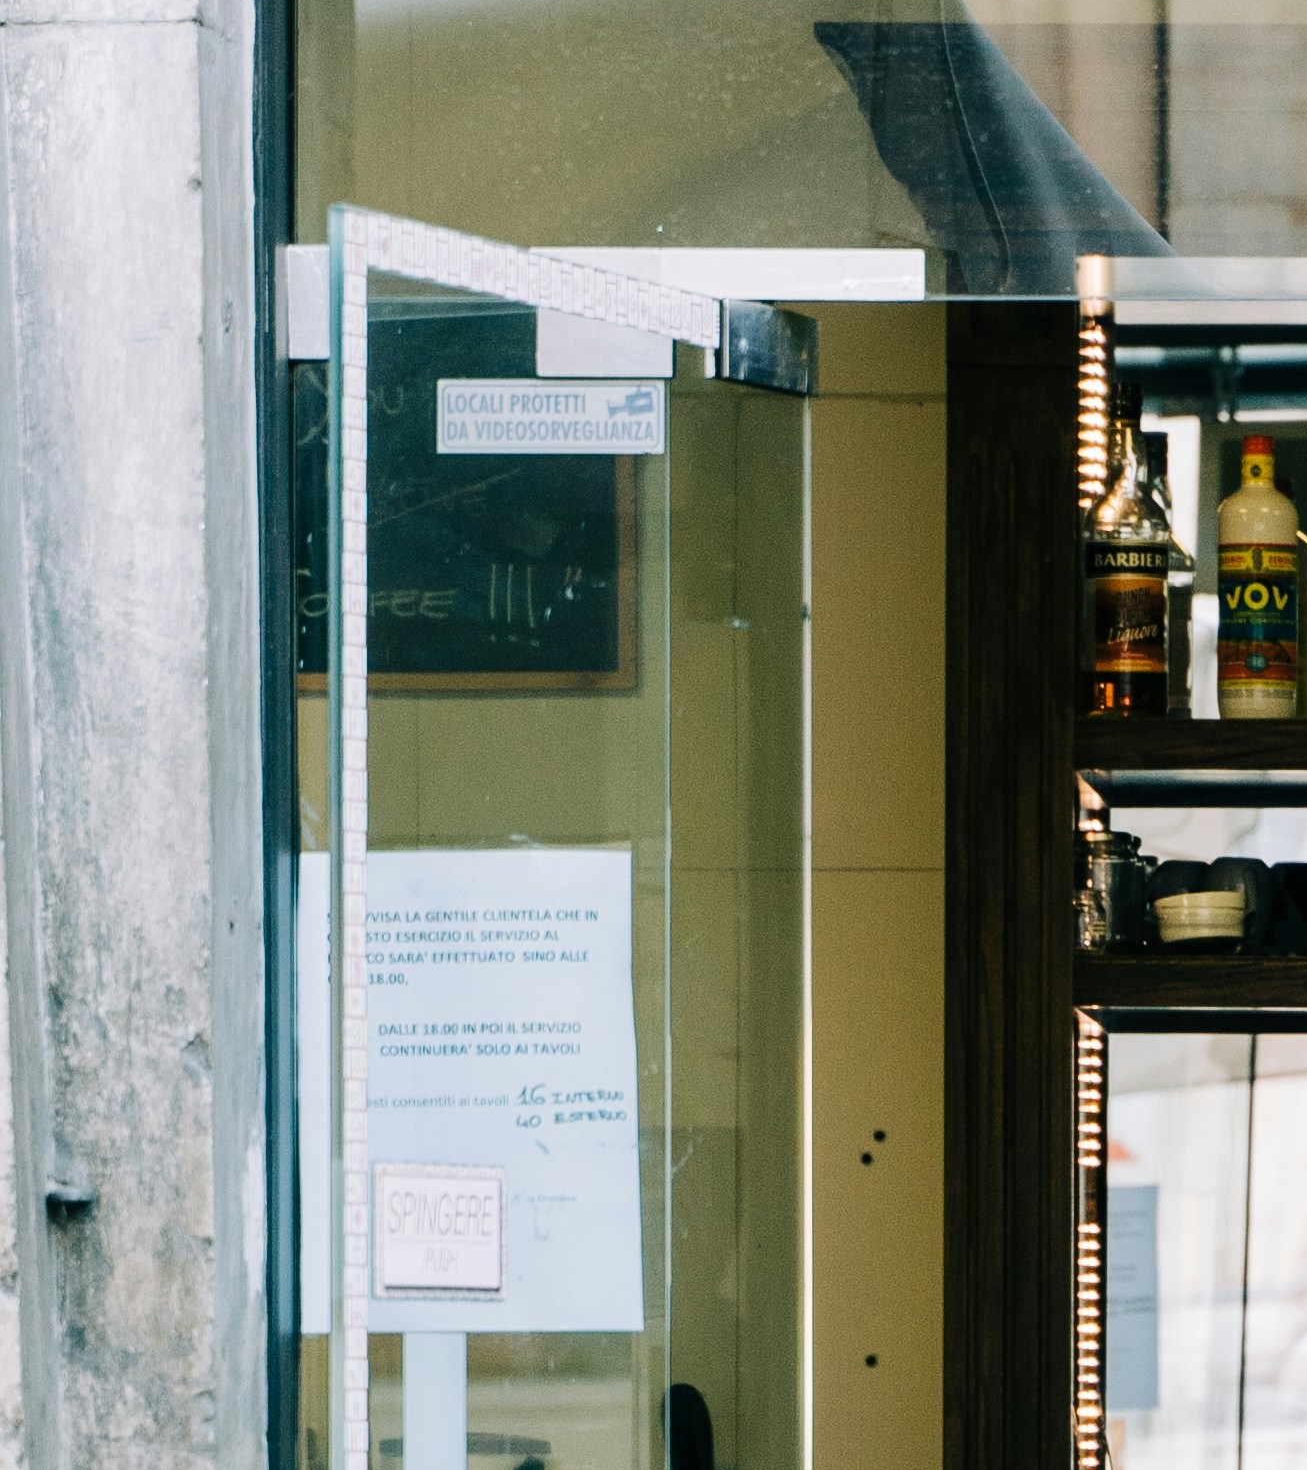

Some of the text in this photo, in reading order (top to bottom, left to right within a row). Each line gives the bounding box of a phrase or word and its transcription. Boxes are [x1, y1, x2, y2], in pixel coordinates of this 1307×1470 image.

[446, 393, 587, 415] LOCALI PROTETTI
[446, 420, 655, 442] DA VIDEOSORVEGLIANZA
[1225, 582, 1289, 611] VOV
[405, 910, 421, 923] LA
[425, 910, 480, 923] GENTILE
[483, 910, 552, 922] CLIENTELA
[556, 909, 581, 922] CHE
[584, 909, 599, 921] IN
[396, 931, 463, 943] ESERCIZIO
[466, 931, 477, 942] IL
[480, 930, 541, 942] SERVIZIO
[432, 951, 516, 964] EFFETTUATO
[522, 950, 556, 963] SINO
[560, 950, 590, 963] ALLE
[378, 1023, 419, 1037] DALLE
[423, 1023, 459, 1036] 18.00
[462, 1023, 477, 1035] IN
[480, 1023, 505, 1035] POI
[521, 1022, 583, 1034] SERVIZIO
[476, 1044, 511, 1056] SOLO
[515, 1043, 530, 1055] AI
[532, 1043, 582, 1055] TAVOLI
[392, 1095, 457, 1108] consentiti
[460, 1095, 472, 1107] ai
[473, 1094, 510, 1107] tavoli
[388, 1191, 495, 1238] SPINGERE
